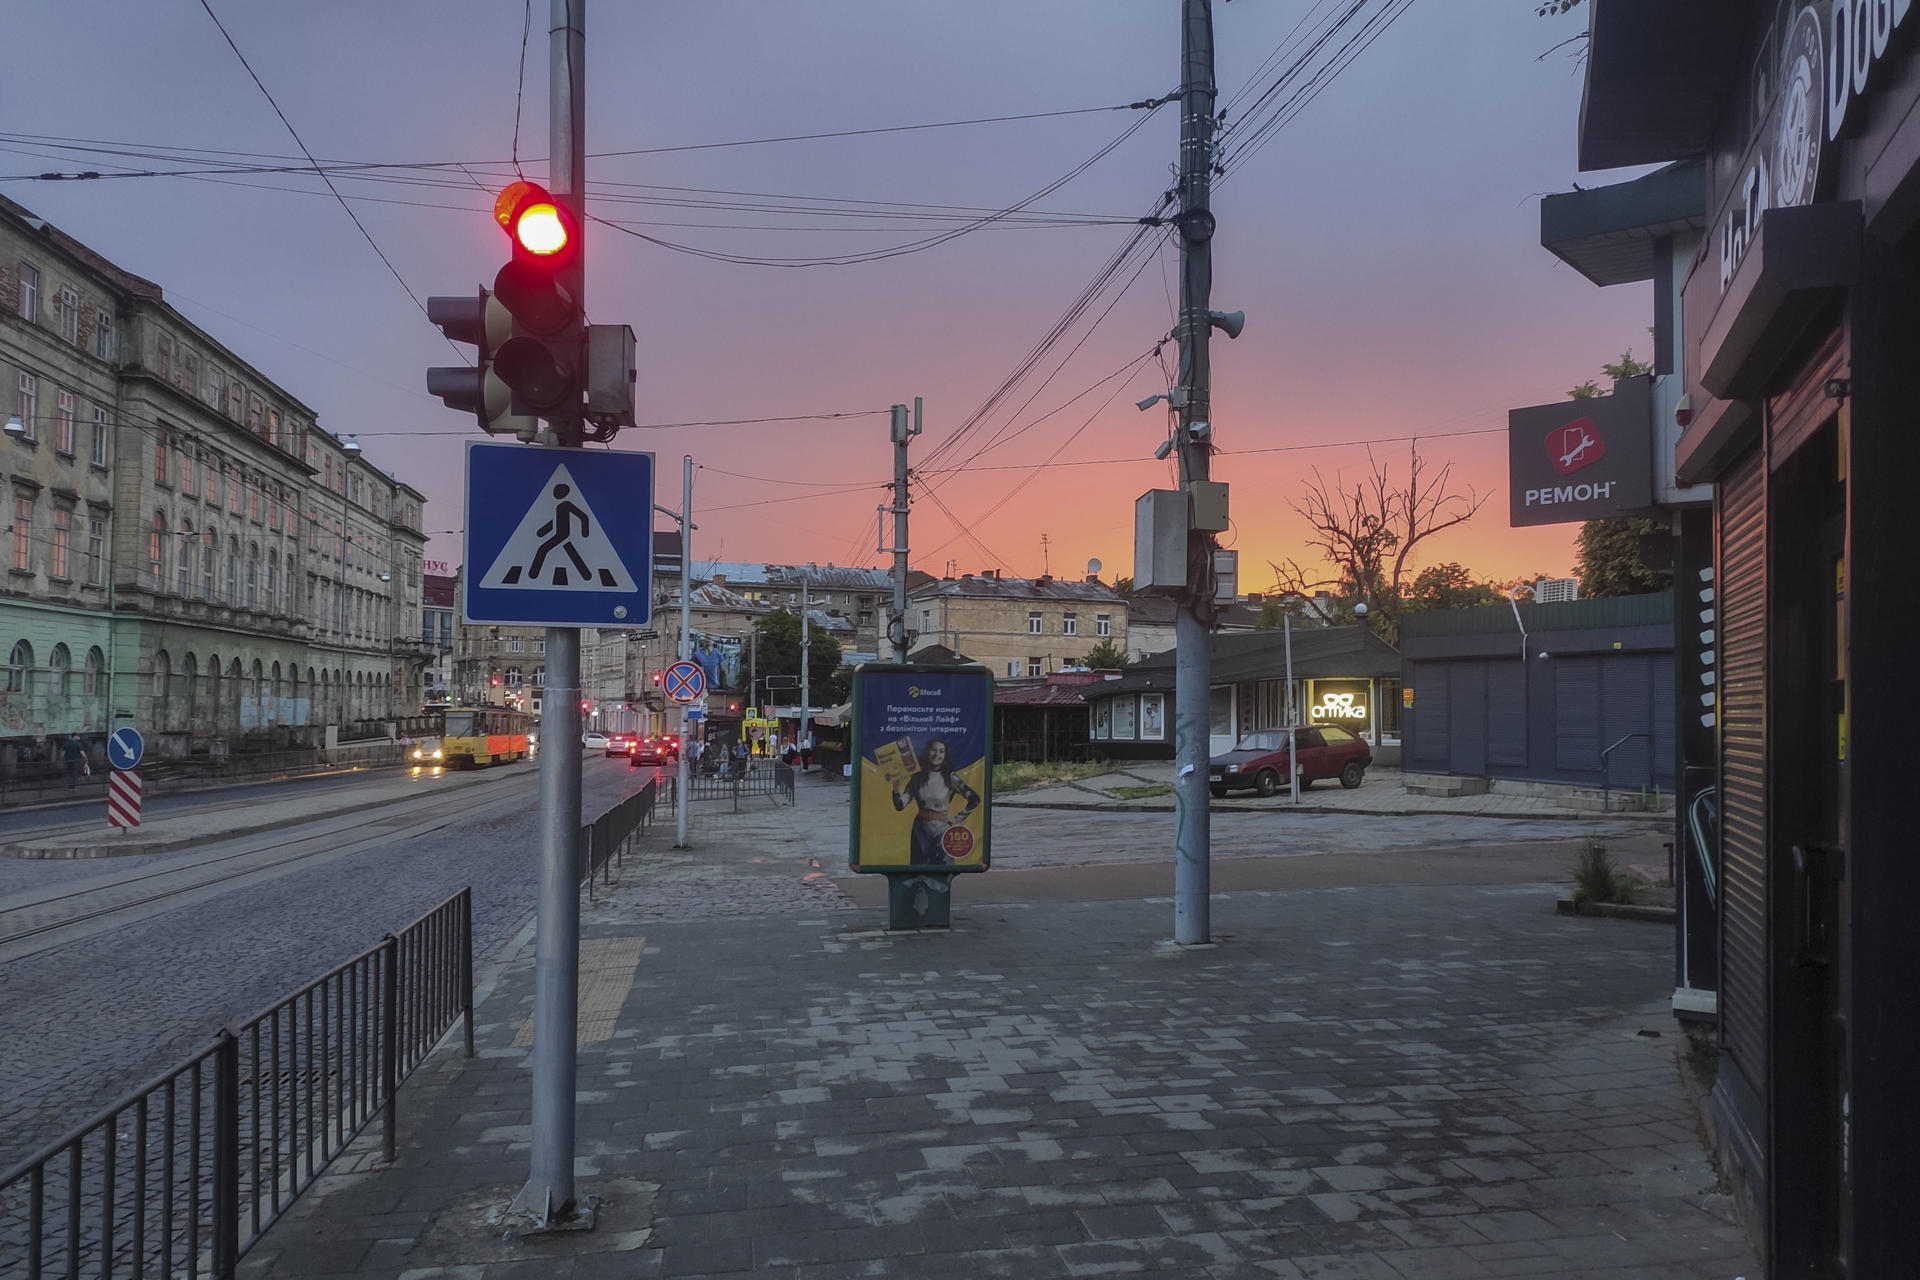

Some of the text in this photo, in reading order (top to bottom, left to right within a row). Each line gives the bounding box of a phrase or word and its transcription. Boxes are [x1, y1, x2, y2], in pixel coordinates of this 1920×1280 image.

[1525, 481, 1616, 506] РЕМОН
[887, 705, 934, 713] Переносьте
[929, 725, 968, 734] інтернету
